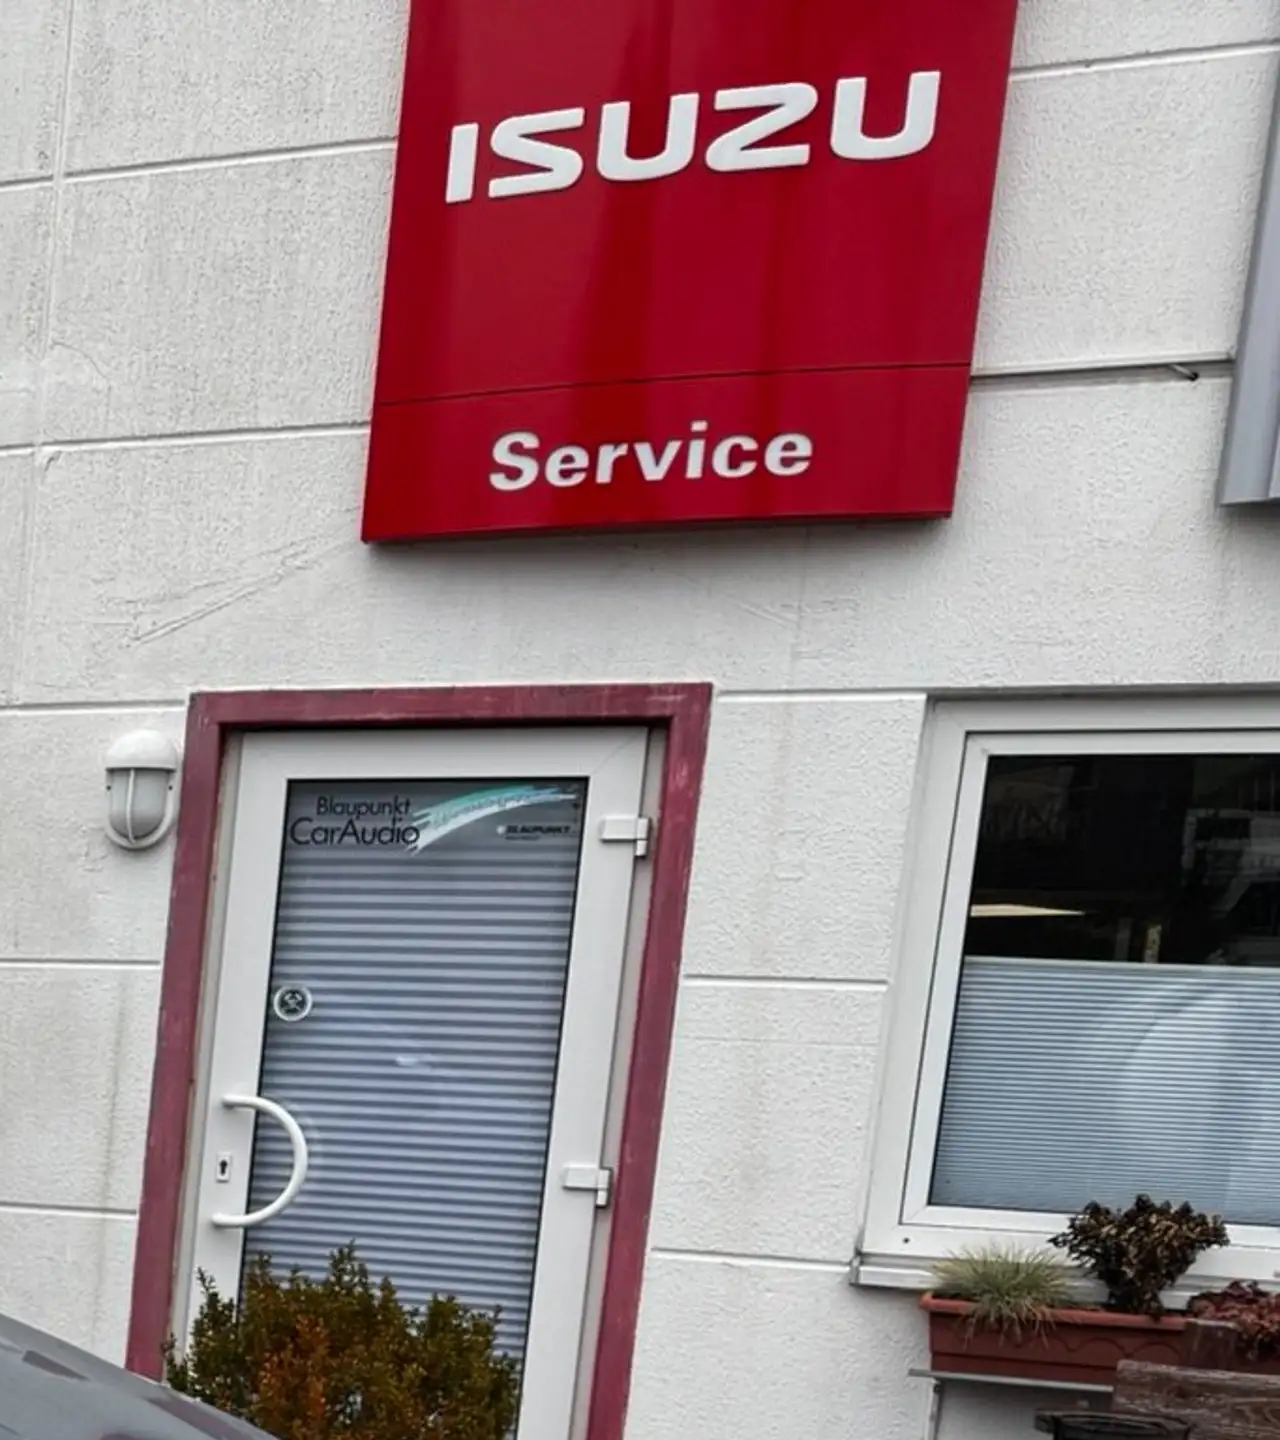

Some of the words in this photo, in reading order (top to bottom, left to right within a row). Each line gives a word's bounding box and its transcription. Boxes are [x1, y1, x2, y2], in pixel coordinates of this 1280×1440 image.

[445, 71, 941, 203] ISUZU
[488, 420, 813, 493] Service
[290, 816, 421, 846] CarAudio
[315, 796, 411, 821] Blaupunkt
